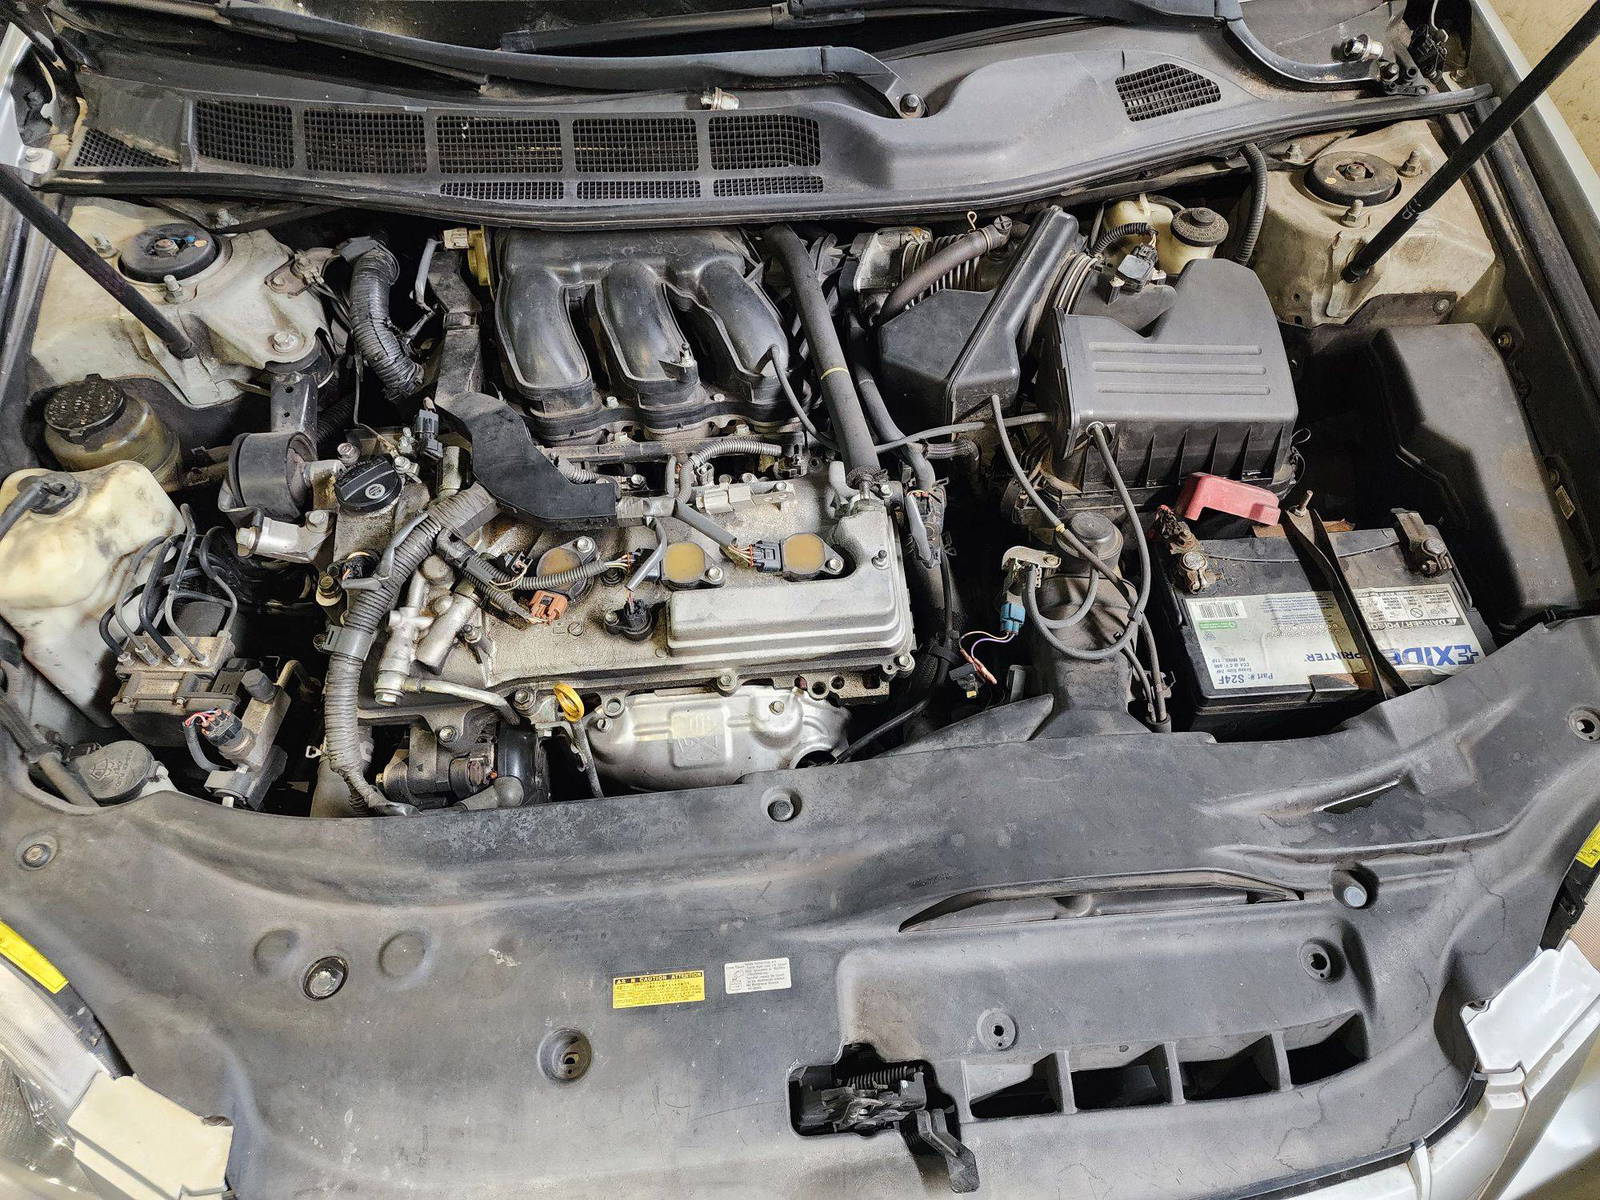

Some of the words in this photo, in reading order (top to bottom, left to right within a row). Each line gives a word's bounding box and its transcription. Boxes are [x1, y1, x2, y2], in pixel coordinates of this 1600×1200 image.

[1306, 651, 1361, 662] PRINTER
[1381, 644, 1479, 666] EXIDE
[1218, 674, 1244, 684] S24F
[639, 975, 667, 983] CAUTION
